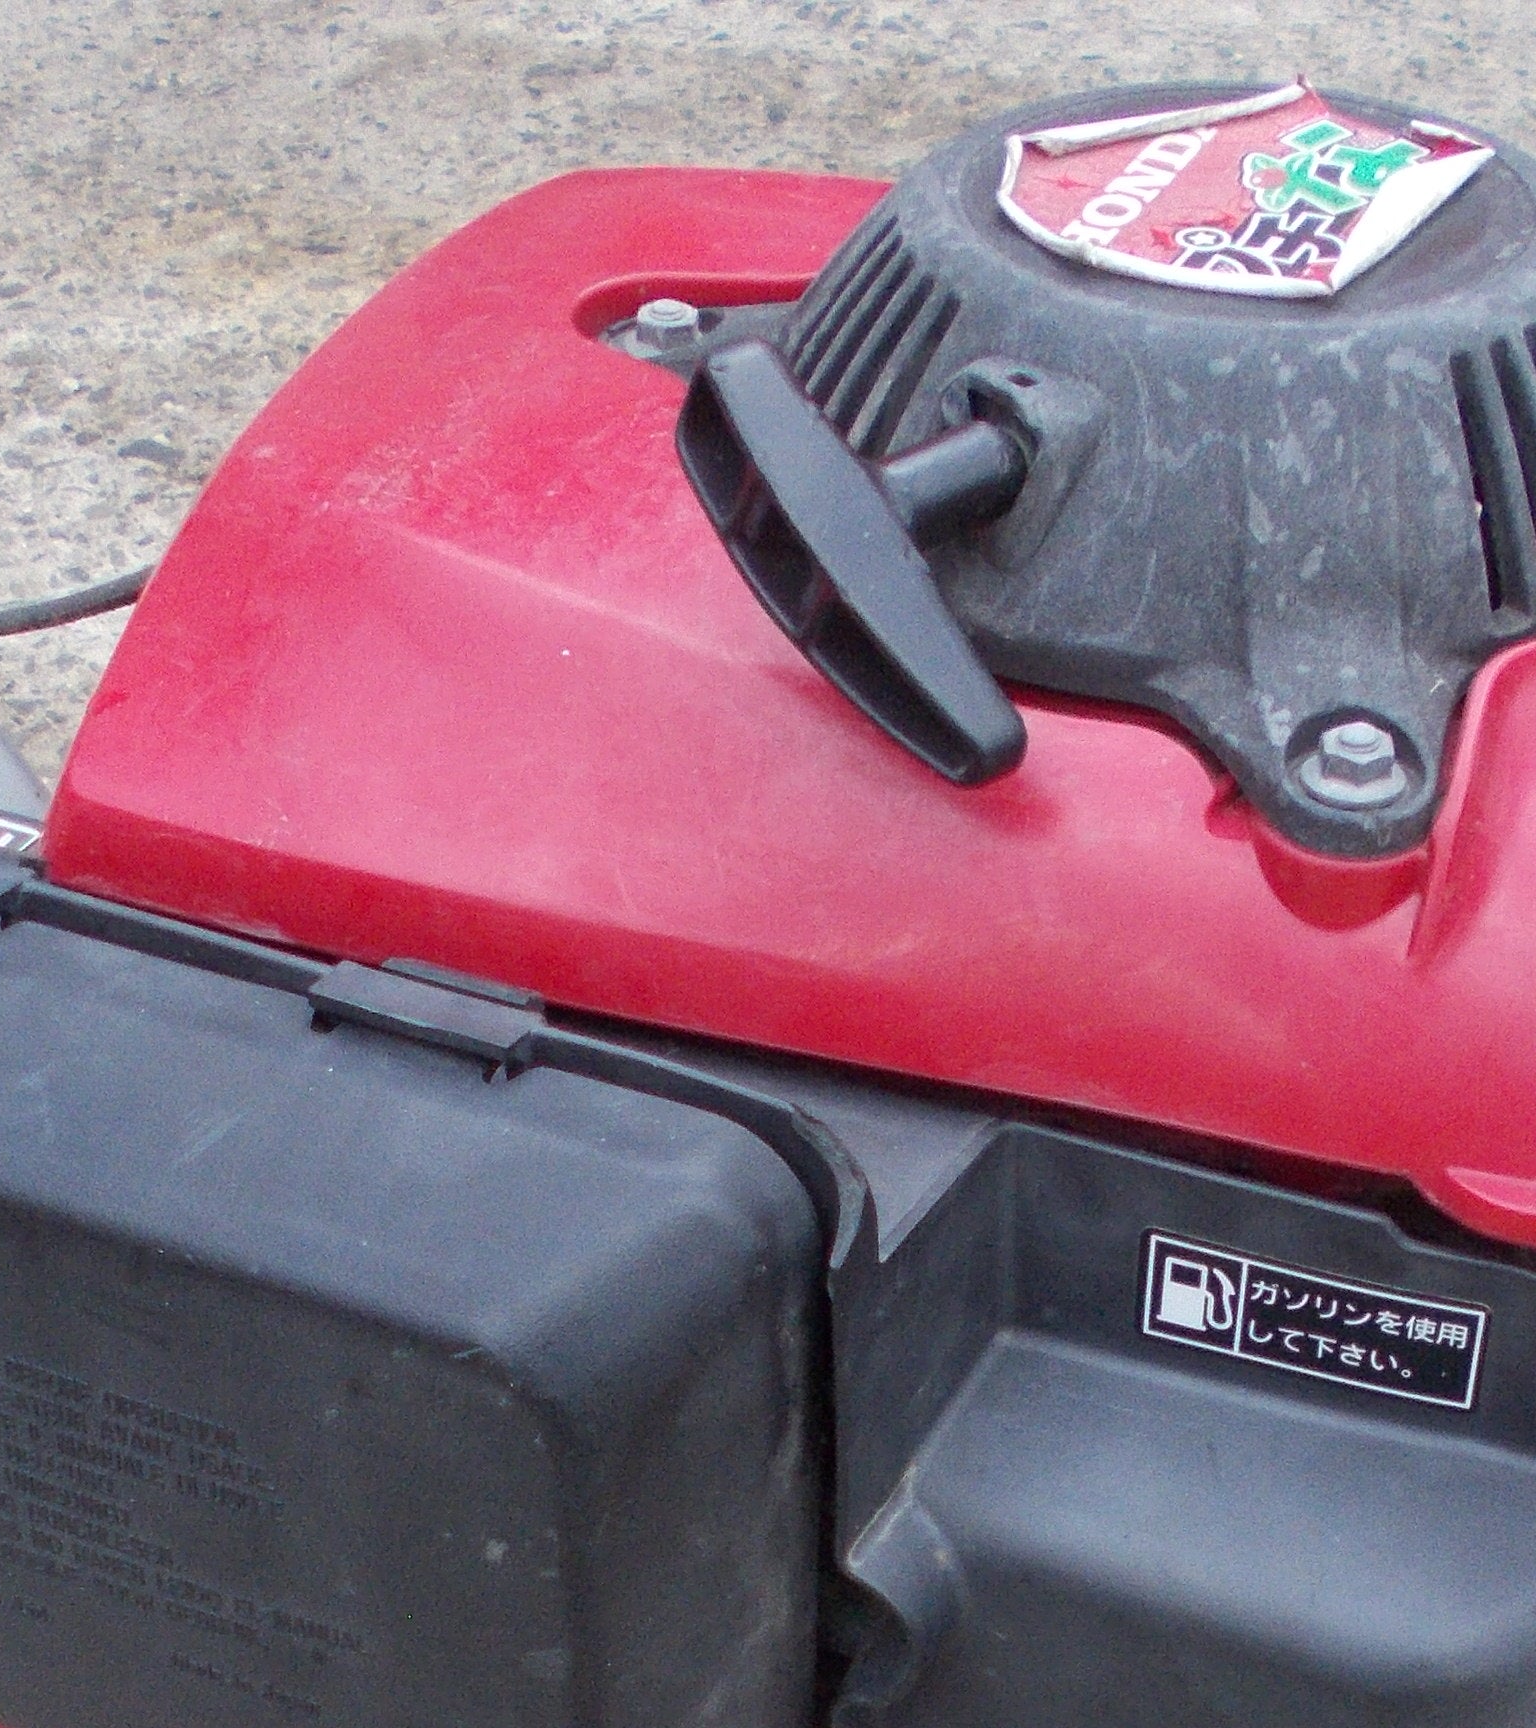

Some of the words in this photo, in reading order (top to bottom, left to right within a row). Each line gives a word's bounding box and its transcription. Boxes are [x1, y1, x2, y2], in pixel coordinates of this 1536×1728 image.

[1250, 1279, 1468, 1349] ガソリンを使用
[1247, 1318, 1412, 1379] して下さい。
